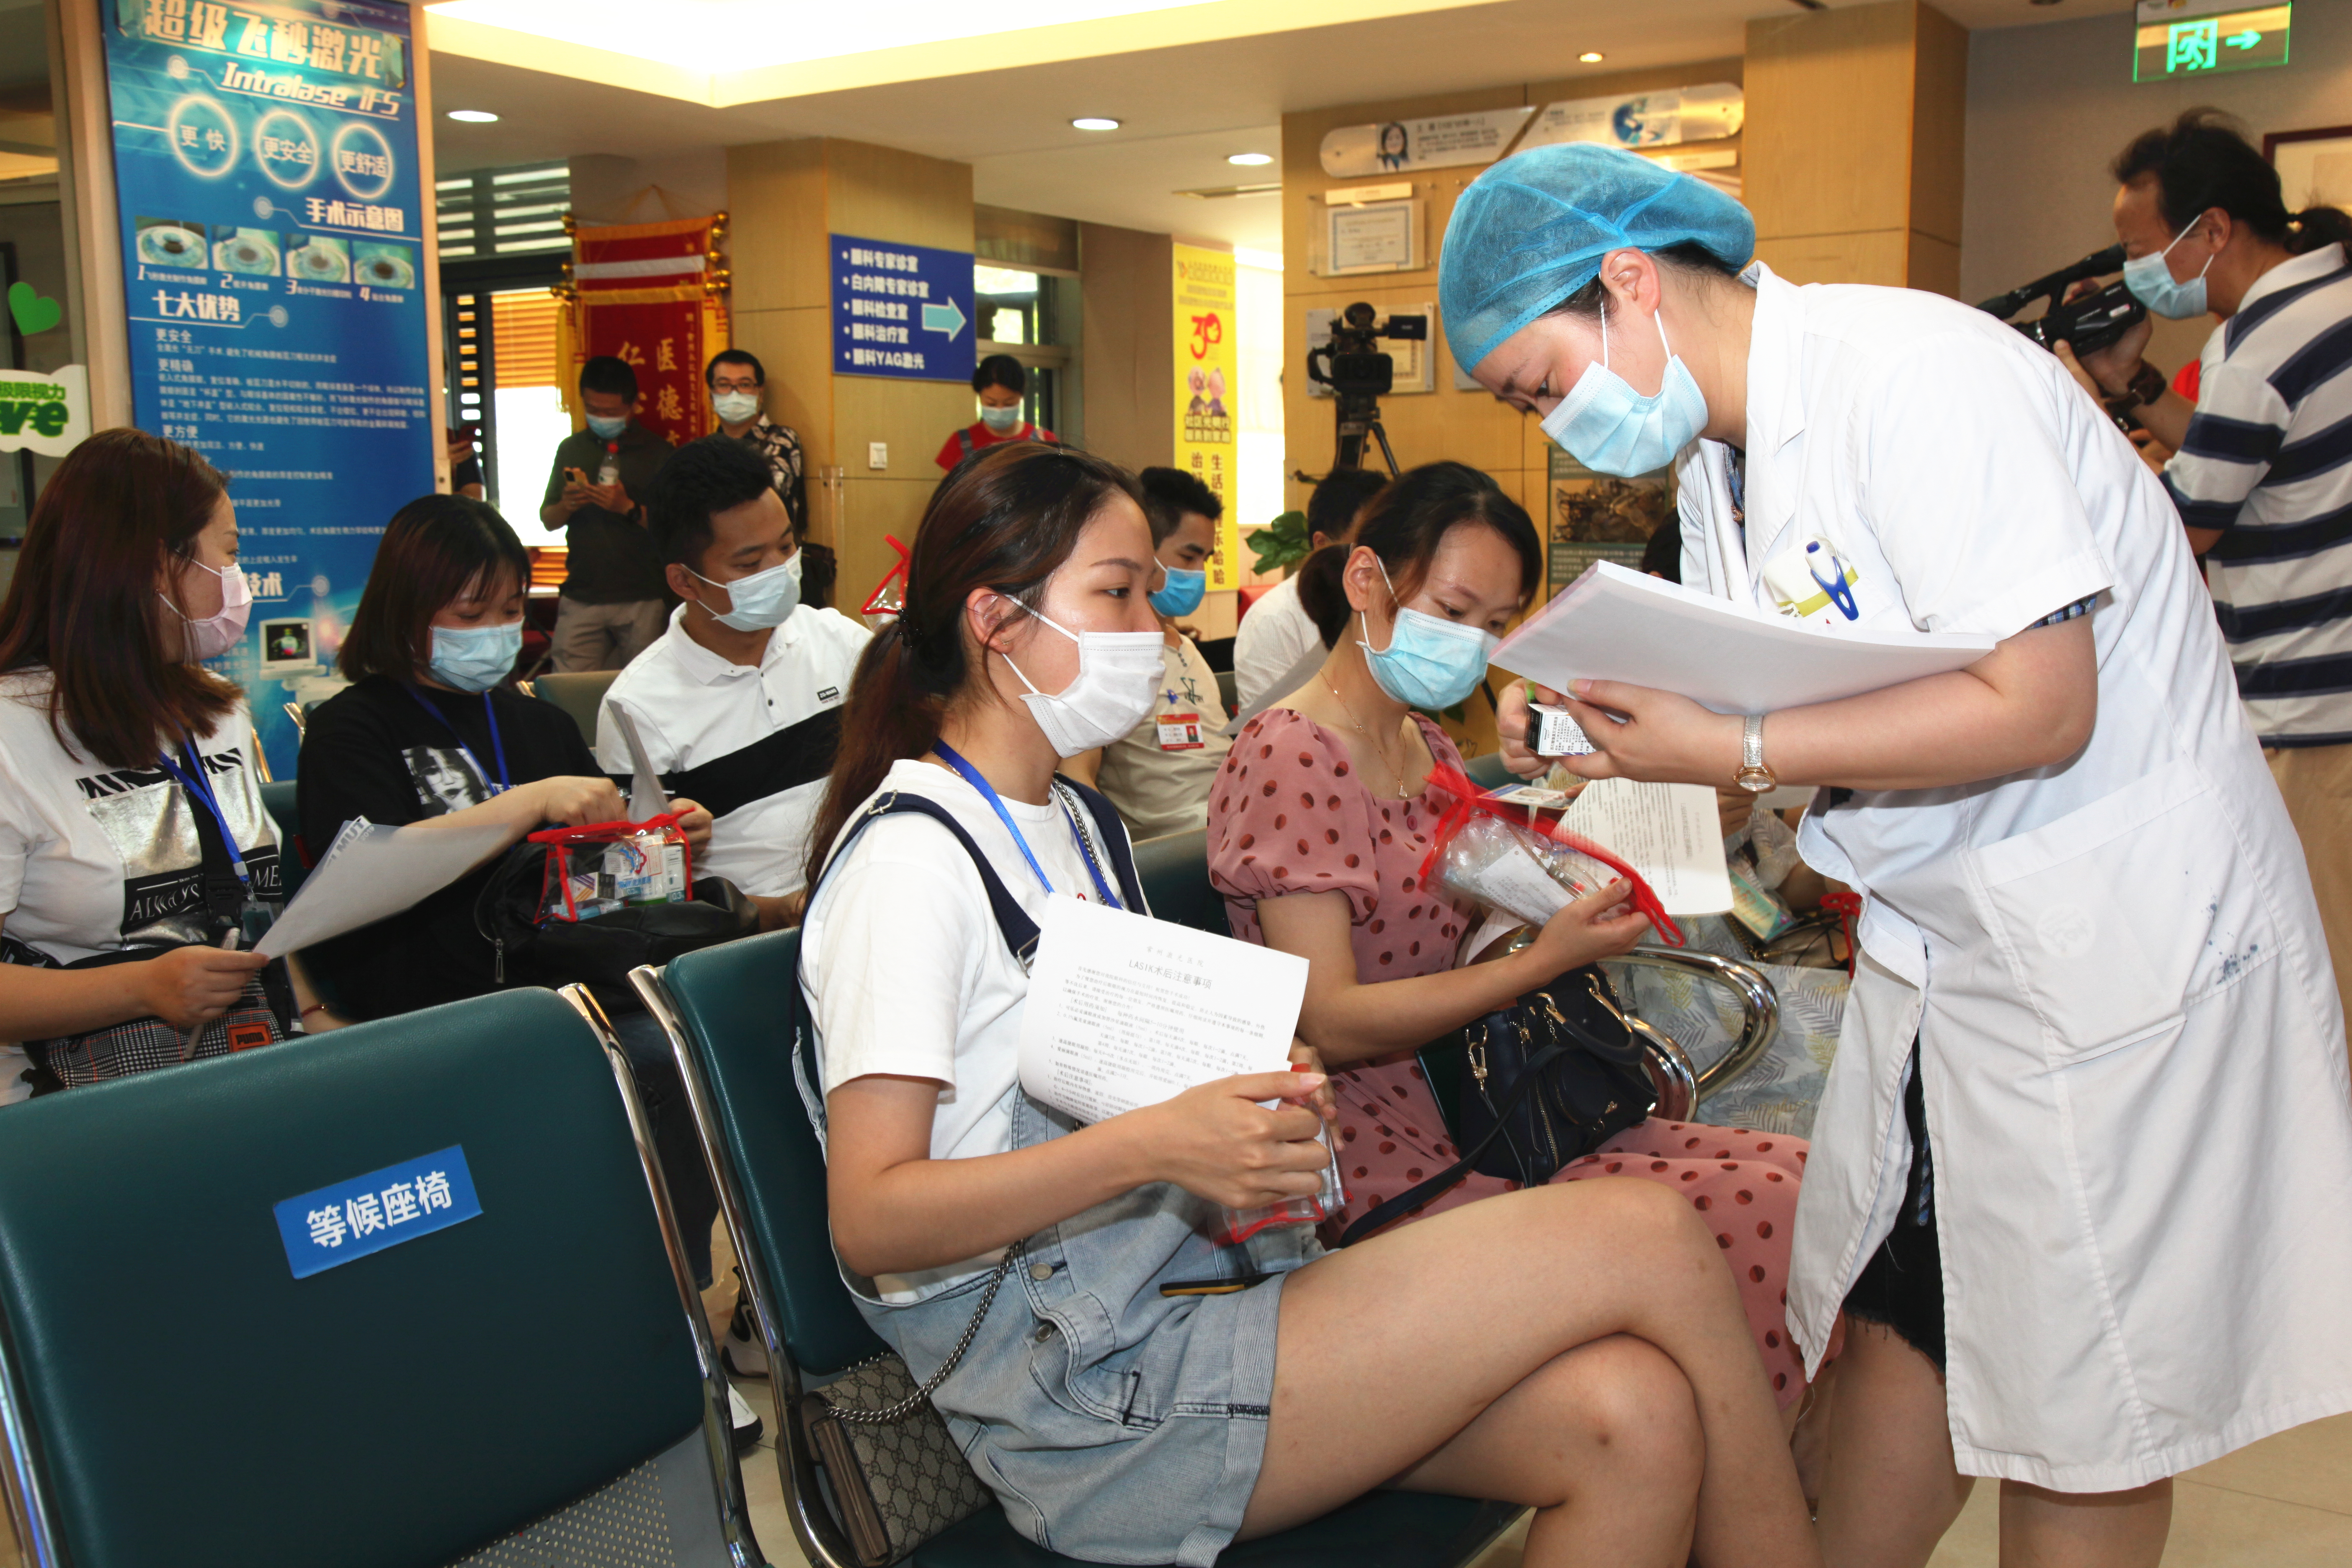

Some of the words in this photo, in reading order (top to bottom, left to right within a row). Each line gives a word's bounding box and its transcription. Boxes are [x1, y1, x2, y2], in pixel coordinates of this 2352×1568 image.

[145, 0, 382, 80] 超级飞秒激光
[222, 62, 347, 108] Intralase
[262, 136, 313, 165] 更安全
[340, 150, 388, 179] 更舒适
[306, 197, 405, 232] 手术示意图
[220, 273, 233, 289] 2
[286, 279, 298, 294] 3
[152, 289, 241, 322] 七大优势
[129, 883, 200, 921] ALWAYS
[1128, 958, 1213, 991] LASIK术后注意事项
[306, 1171, 453, 1248] 等候座椅
